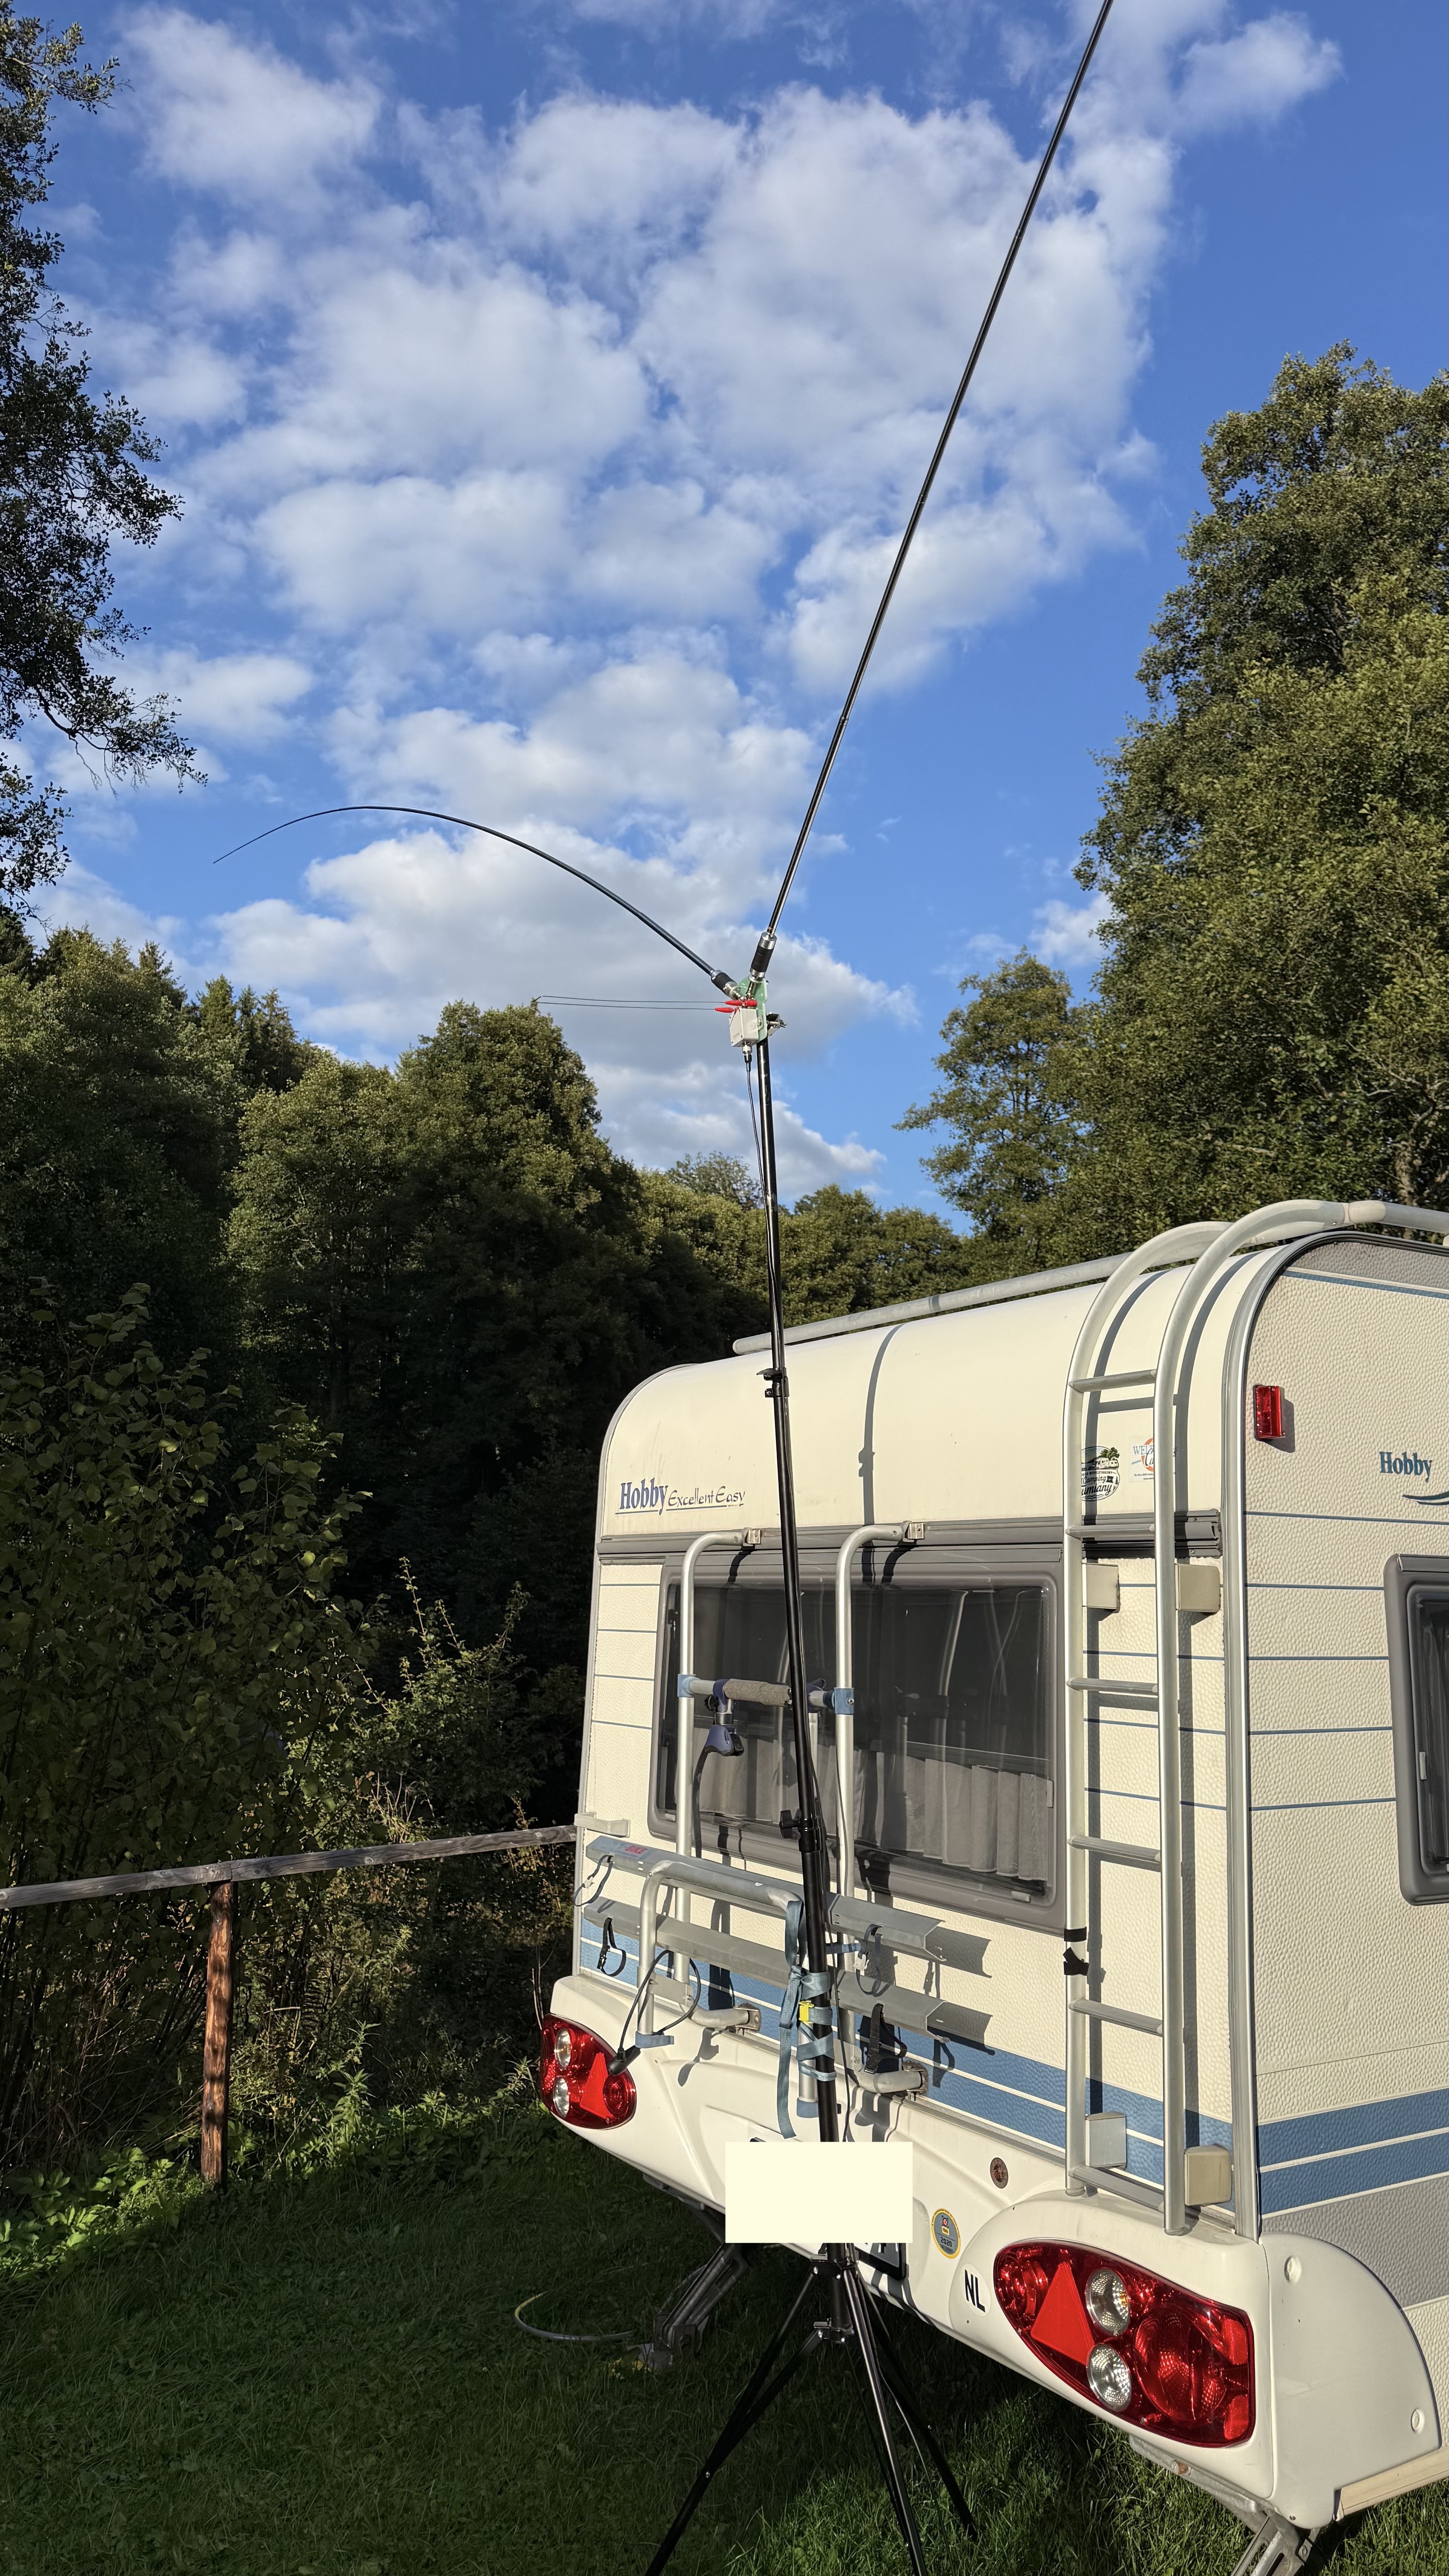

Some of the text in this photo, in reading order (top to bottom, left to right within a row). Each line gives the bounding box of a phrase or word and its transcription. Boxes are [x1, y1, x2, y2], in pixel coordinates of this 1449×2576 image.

[1379, 1451, 1432, 1483] Hobby
[619, 1477, 745, 1515] Hobby Excellent Easy
[1081, 1484, 1112, 1495] umiany
[940, 2236, 952, 2247] 2020
[965, 2269, 985, 2313] NL
